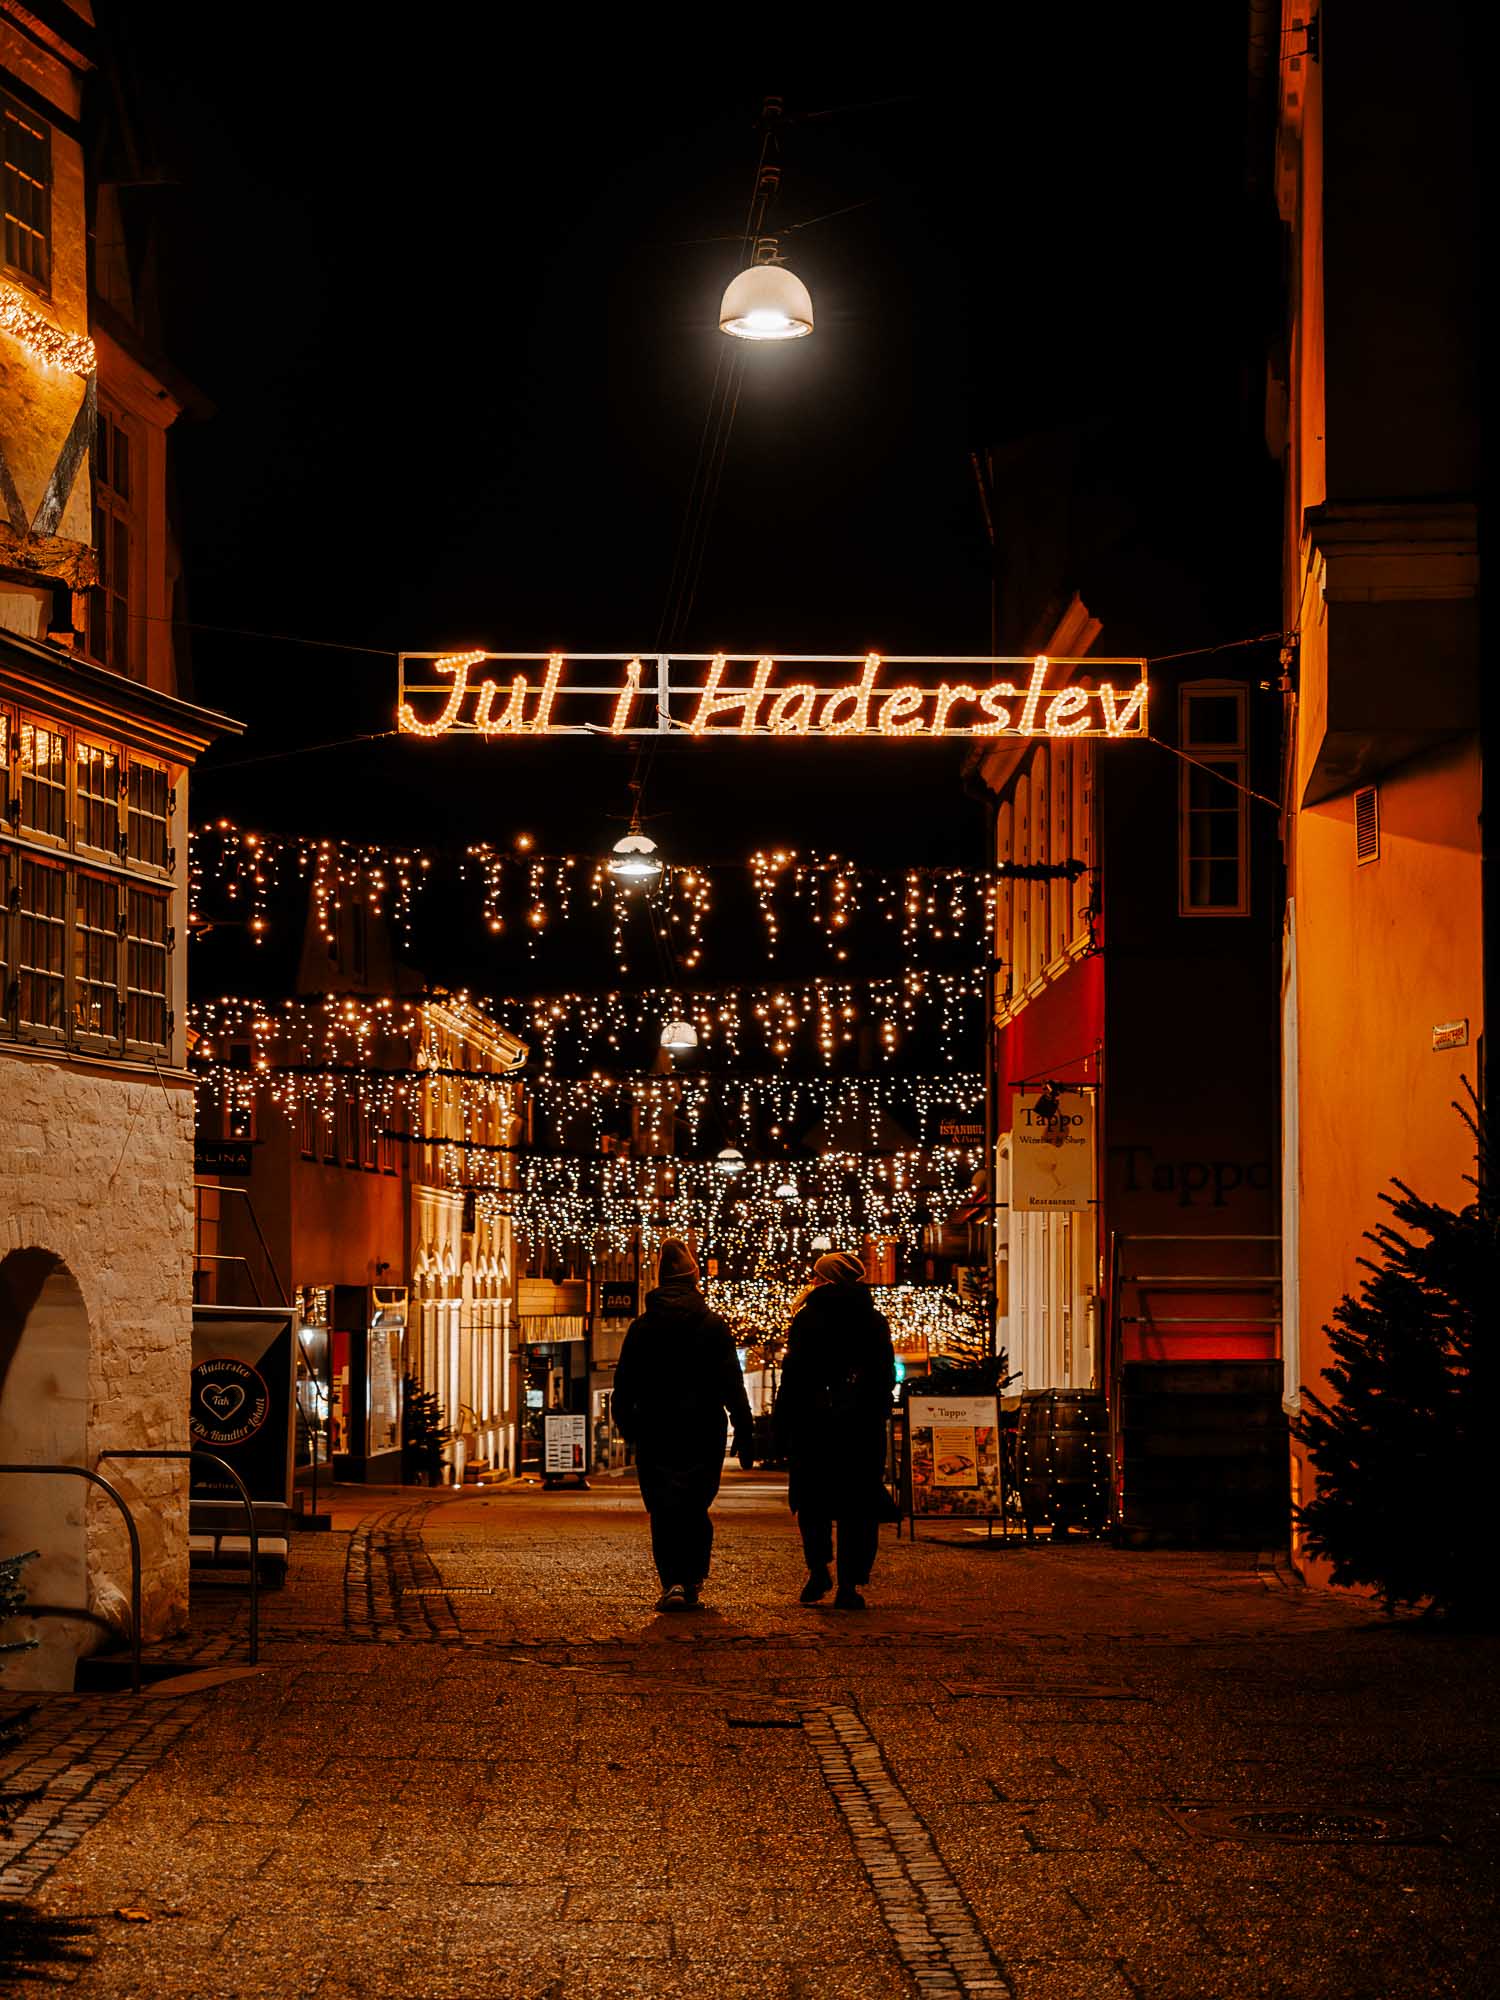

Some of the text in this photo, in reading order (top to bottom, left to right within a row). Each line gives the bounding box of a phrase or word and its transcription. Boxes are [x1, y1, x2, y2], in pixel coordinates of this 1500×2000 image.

[399, 650, 1149, 738] Jul i Haderslev
[1020, 1108, 1084, 1133] Tappo
[1107, 1145, 1273, 1207] Tappo
[1029, 1196, 1075, 1206] Restaurant
[211, 1395, 230, 1406] Tak
[937, 1407, 967, 1419] Tappo
